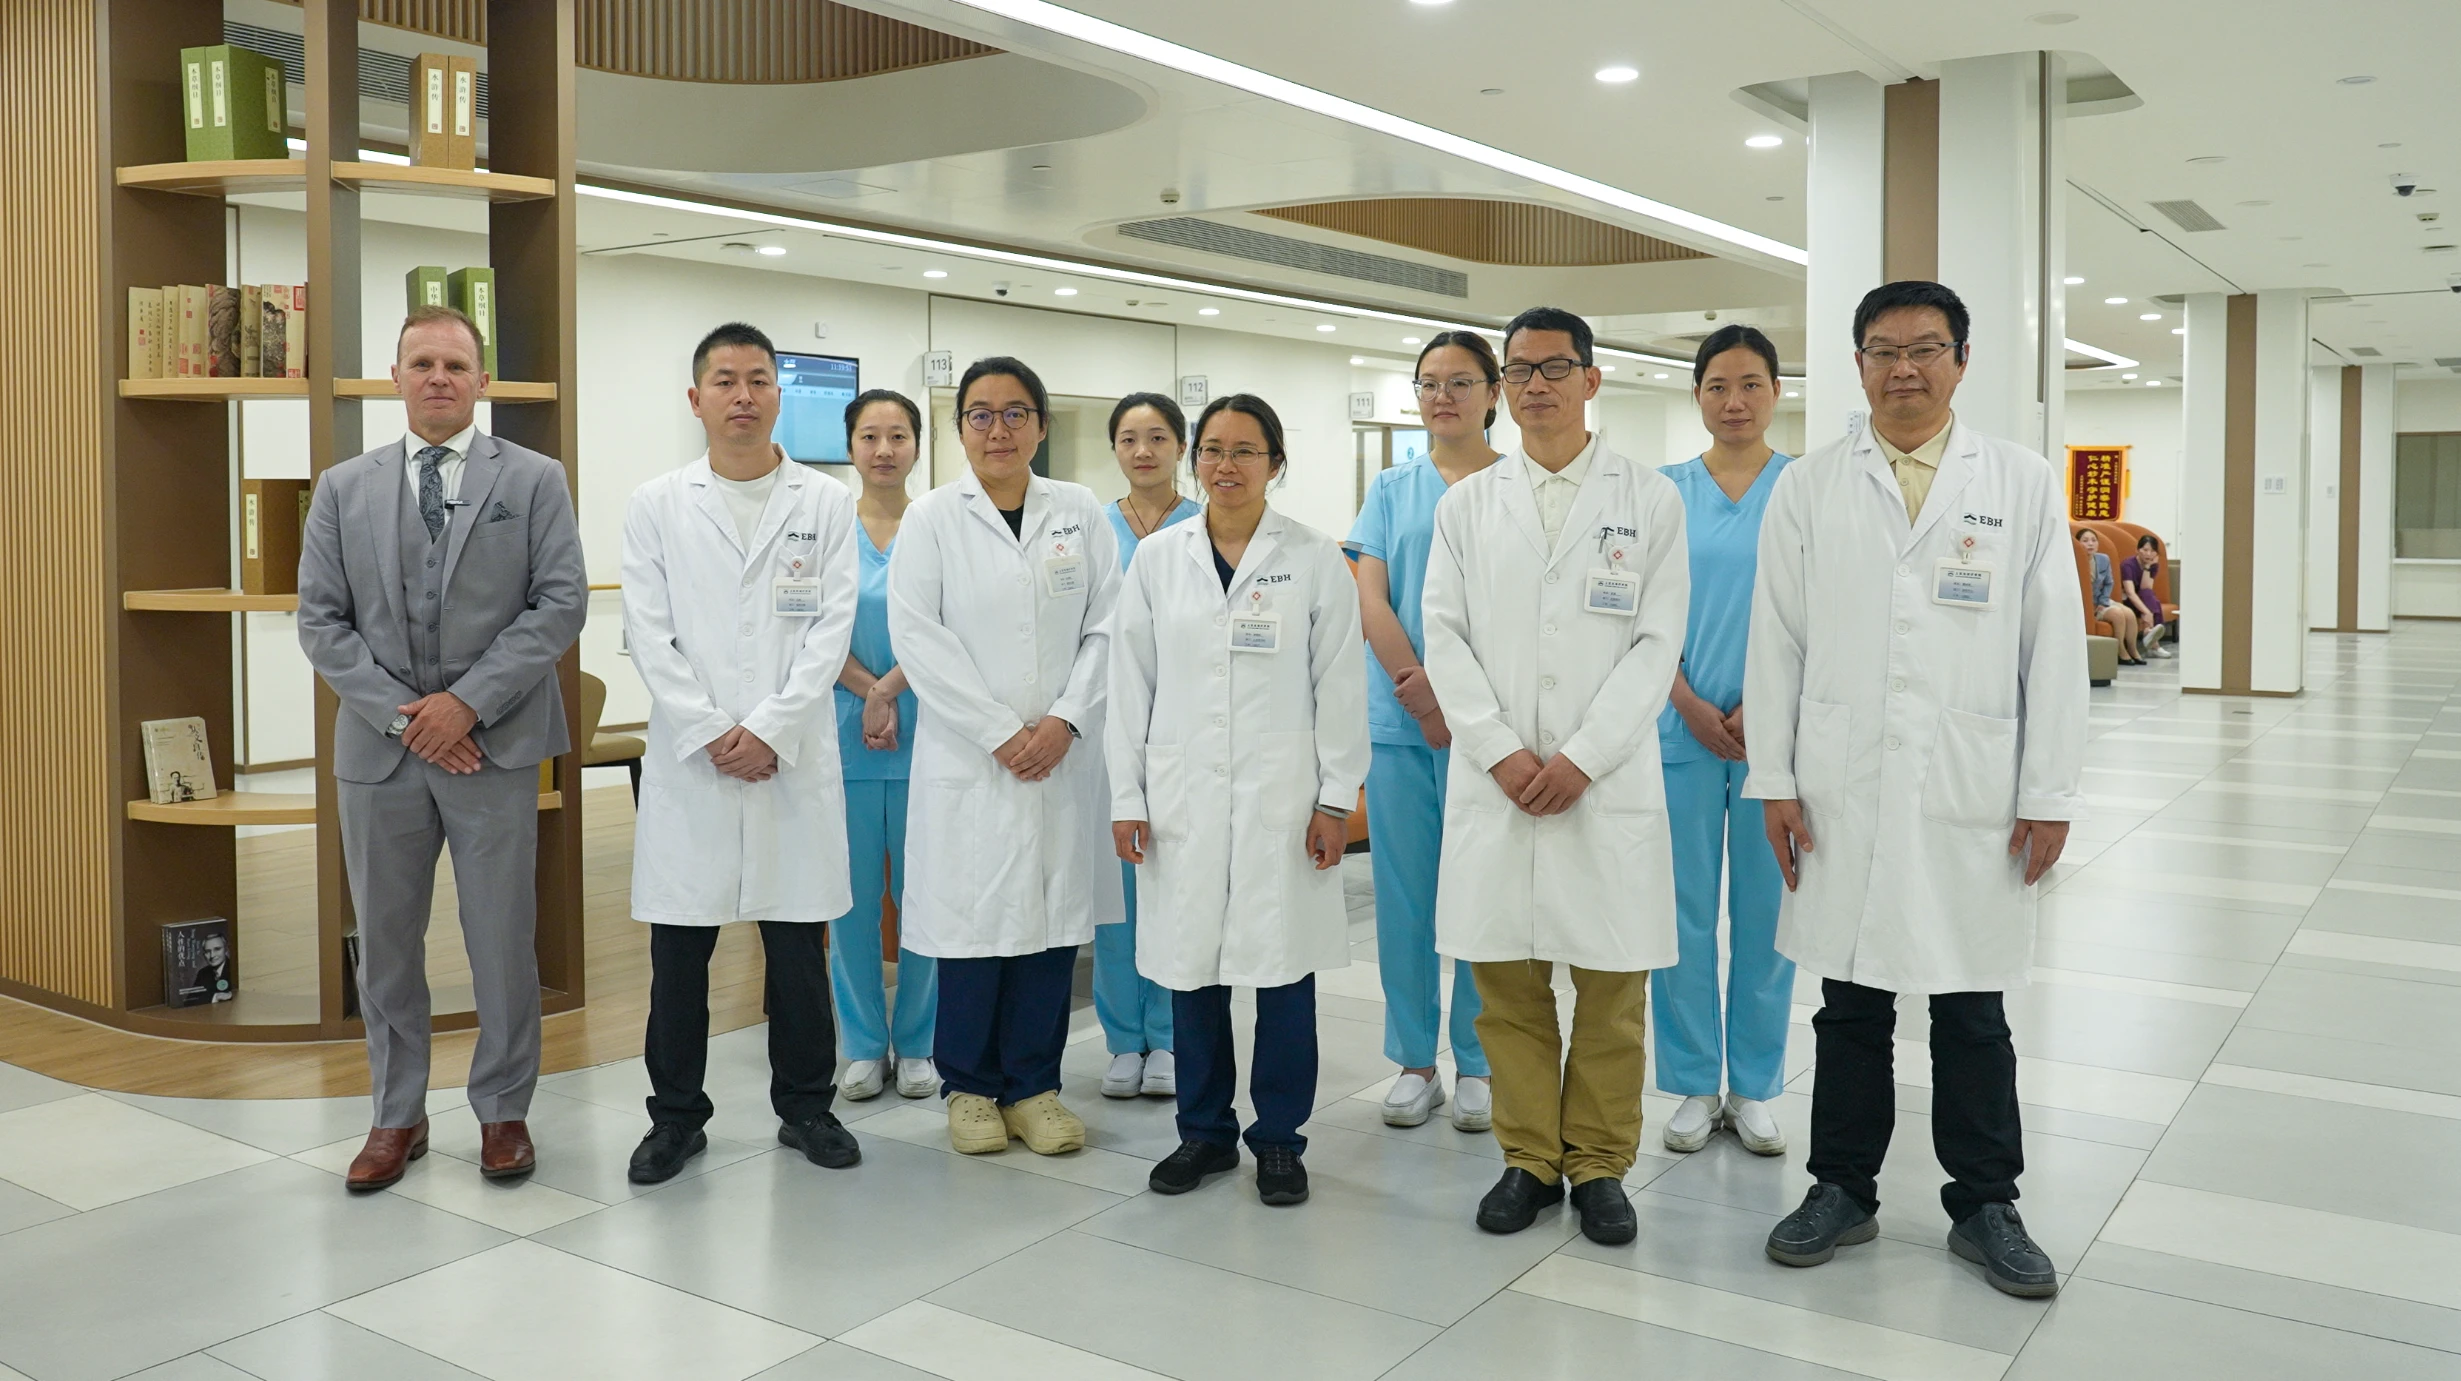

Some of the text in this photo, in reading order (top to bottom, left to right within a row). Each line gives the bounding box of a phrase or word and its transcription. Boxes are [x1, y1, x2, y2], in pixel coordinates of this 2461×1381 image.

[931, 358, 948, 371] 113
[1188, 382, 1204, 393] 112
[1356, 397, 1370, 407] 111
[1979, 515, 2003, 527] EBH
[1062, 524, 1081, 535] EBH
[1616, 526, 1637, 538] EBH
[1269, 573, 1292, 583] EBH
